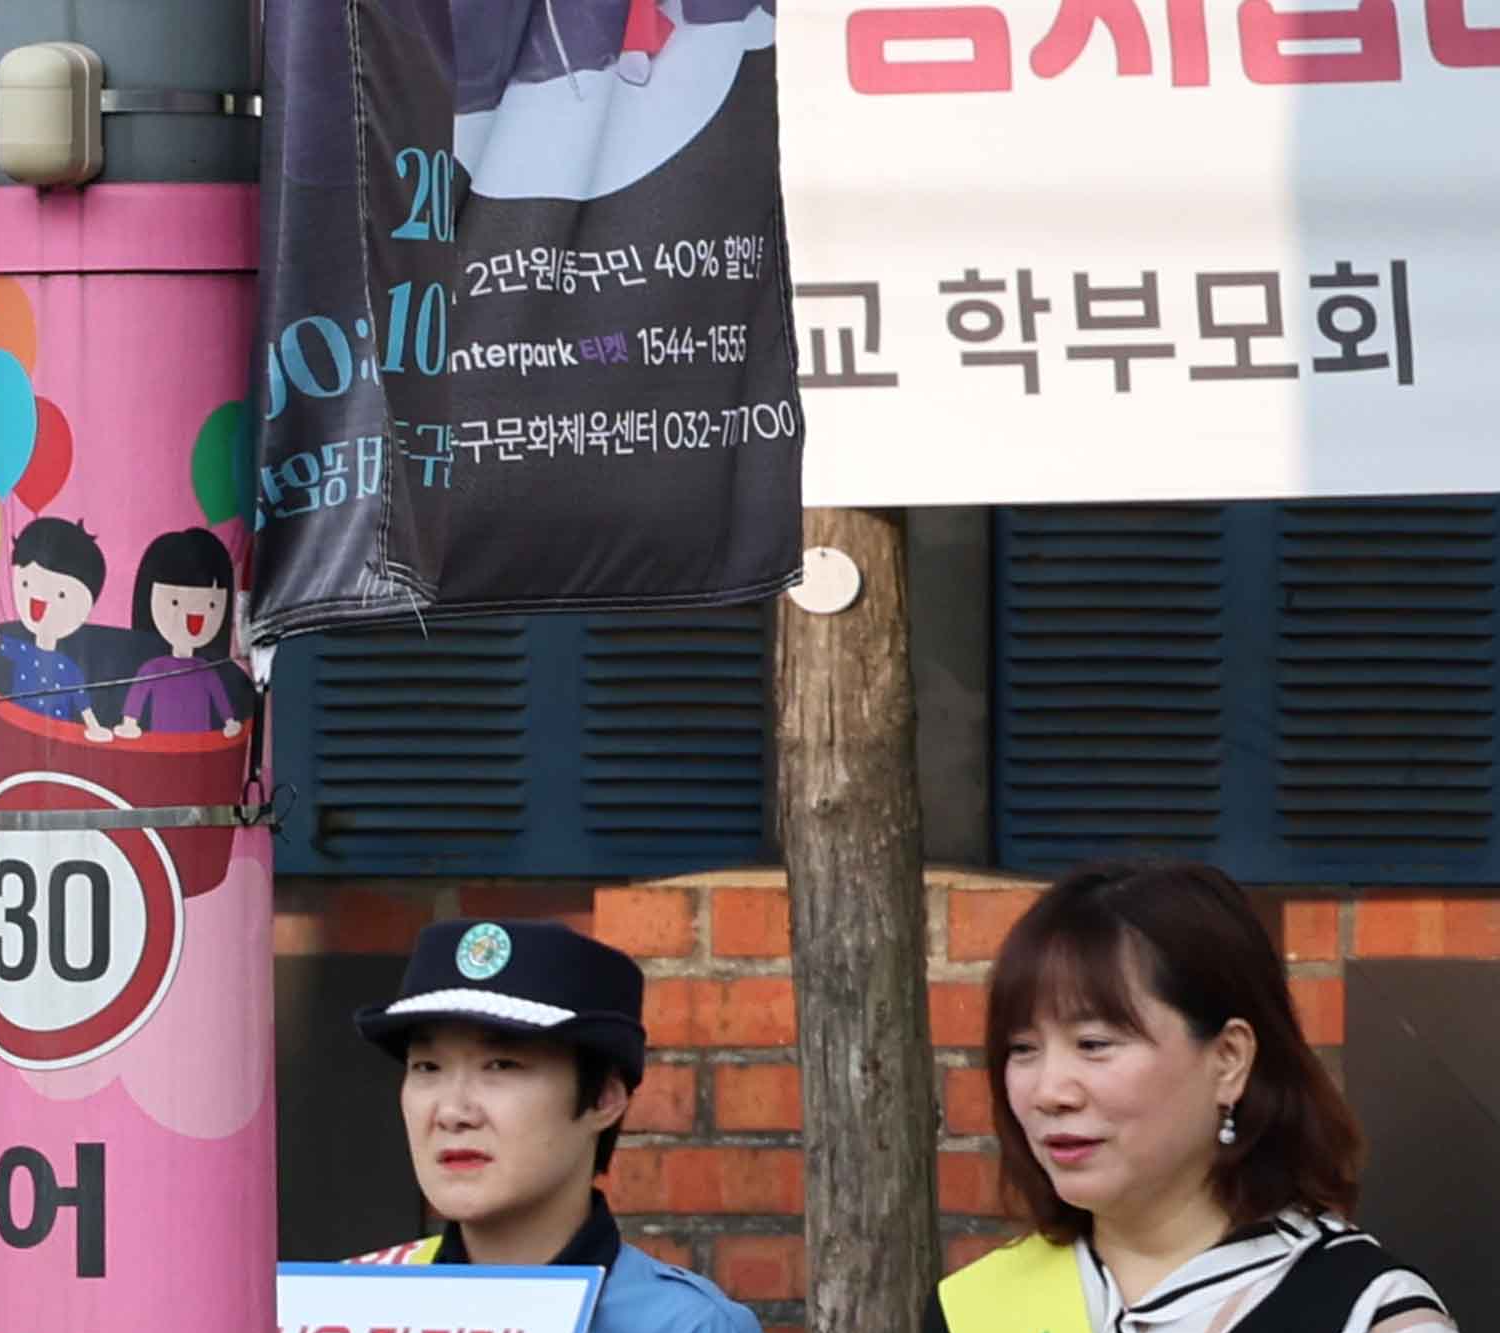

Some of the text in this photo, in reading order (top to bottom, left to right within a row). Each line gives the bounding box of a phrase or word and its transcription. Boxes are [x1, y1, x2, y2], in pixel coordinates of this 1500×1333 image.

[654, 240, 720, 279] 40%
[450, 338, 579, 377] nterpark
[637, 325, 748, 365] 1544-1555
[938, 259, 1417, 396] 학부모회
[451, 410, 658, 464] 구문화체육센터
